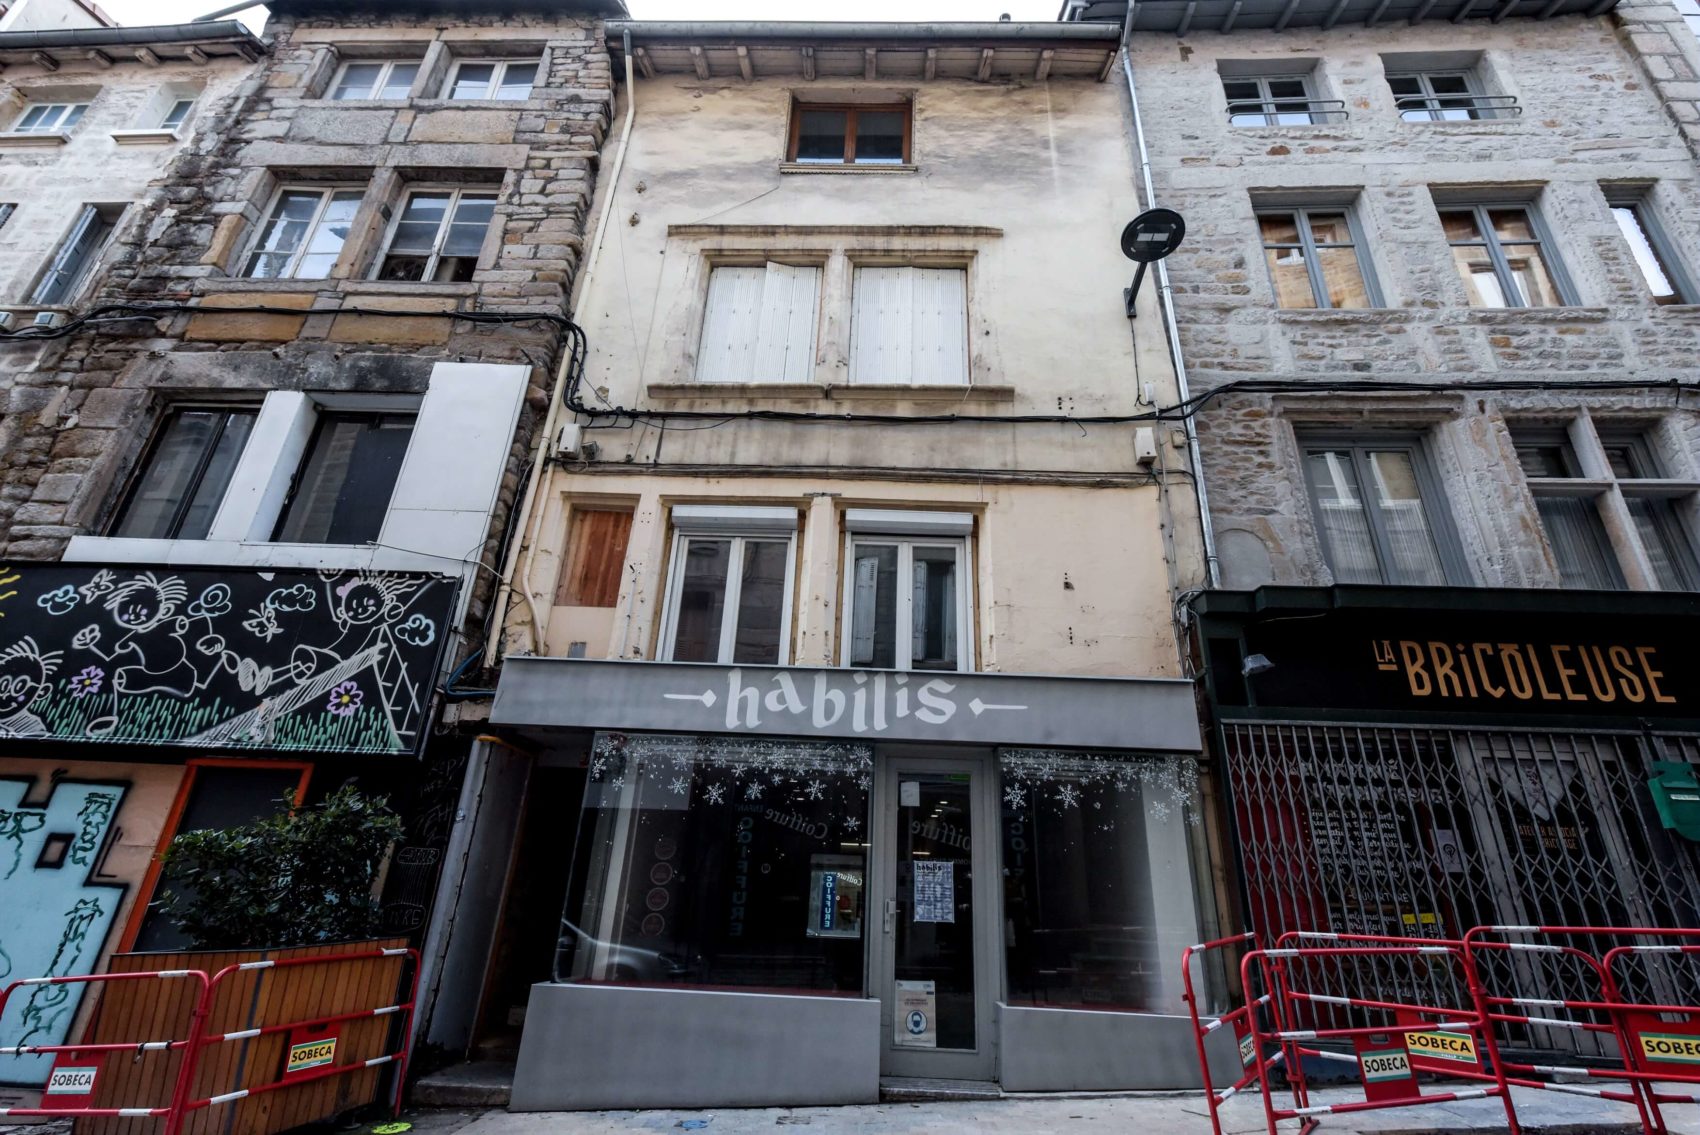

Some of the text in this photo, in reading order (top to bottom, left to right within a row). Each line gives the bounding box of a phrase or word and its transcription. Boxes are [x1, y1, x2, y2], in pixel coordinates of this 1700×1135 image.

[1372, 640, 1397, 663] LA
[725, 668, 957, 733] habilis
[1407, 1033, 1472, 1053] SOBECA
[1644, 1040, 1700, 1056] SOBE
[291, 1045, 332, 1063] SOBECA
[1364, 1056, 1408, 1073] SOBECA
[51, 1073, 92, 1086] SOBECA
